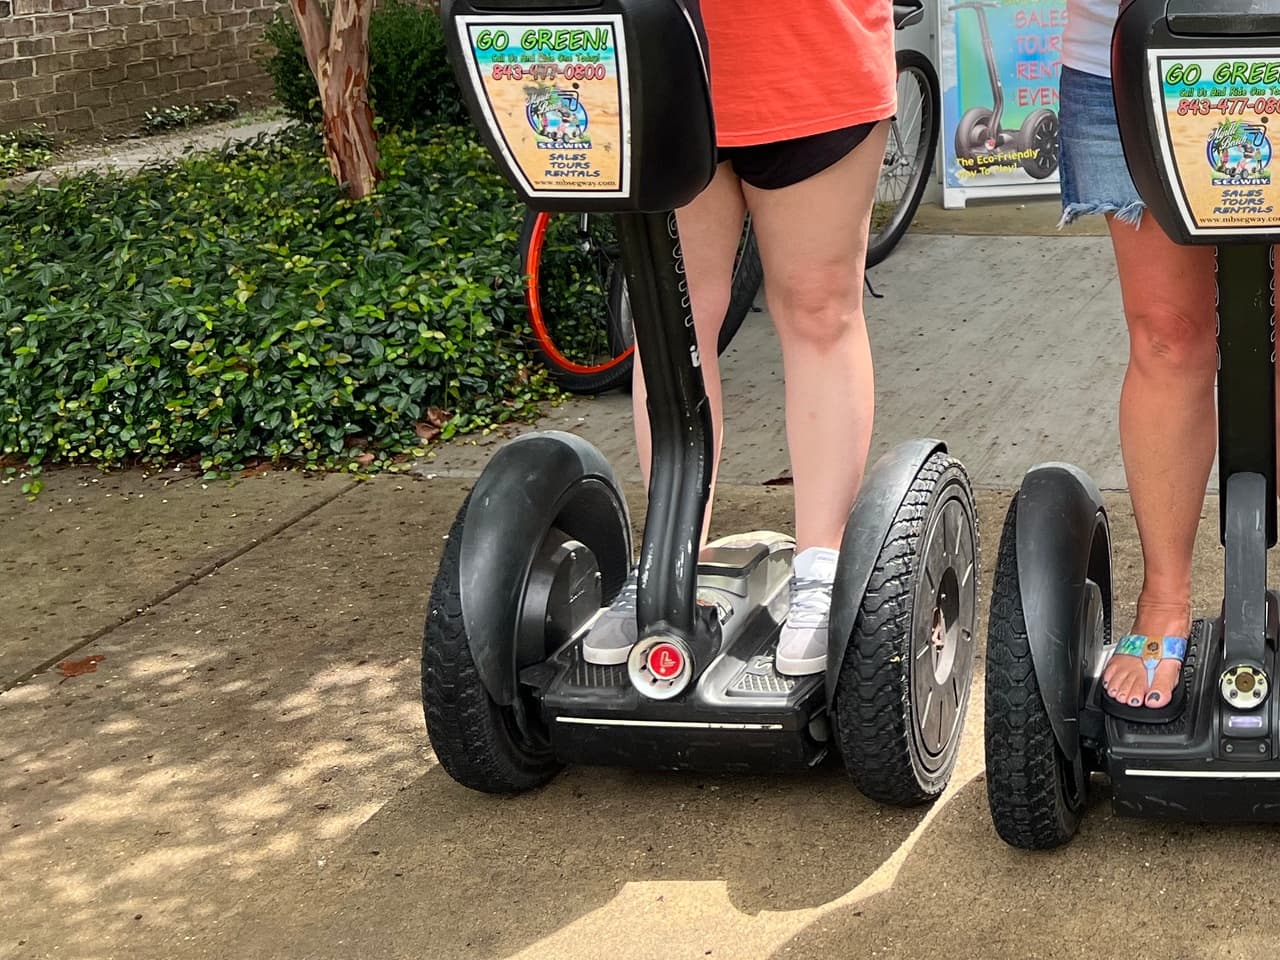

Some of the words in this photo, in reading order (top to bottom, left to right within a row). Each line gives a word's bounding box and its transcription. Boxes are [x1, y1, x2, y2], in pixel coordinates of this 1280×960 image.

[476, 28, 510, 51] GO
[521, 27, 609, 51] GREEN!
[491, 63, 606, 81] 843-477-0800
[1166, 63, 1201, 86] GO
[549, 153, 587, 161] SALES
[956, 157, 974, 167] The
[977, 147, 1040, 164] Eco-Friendly
[979, 166, 991, 175] To
[1221, 189, 1263, 197] SALES
[1221, 198, 1264, 206] TOURS
[1213, 205, 1274, 214] RENTALS
